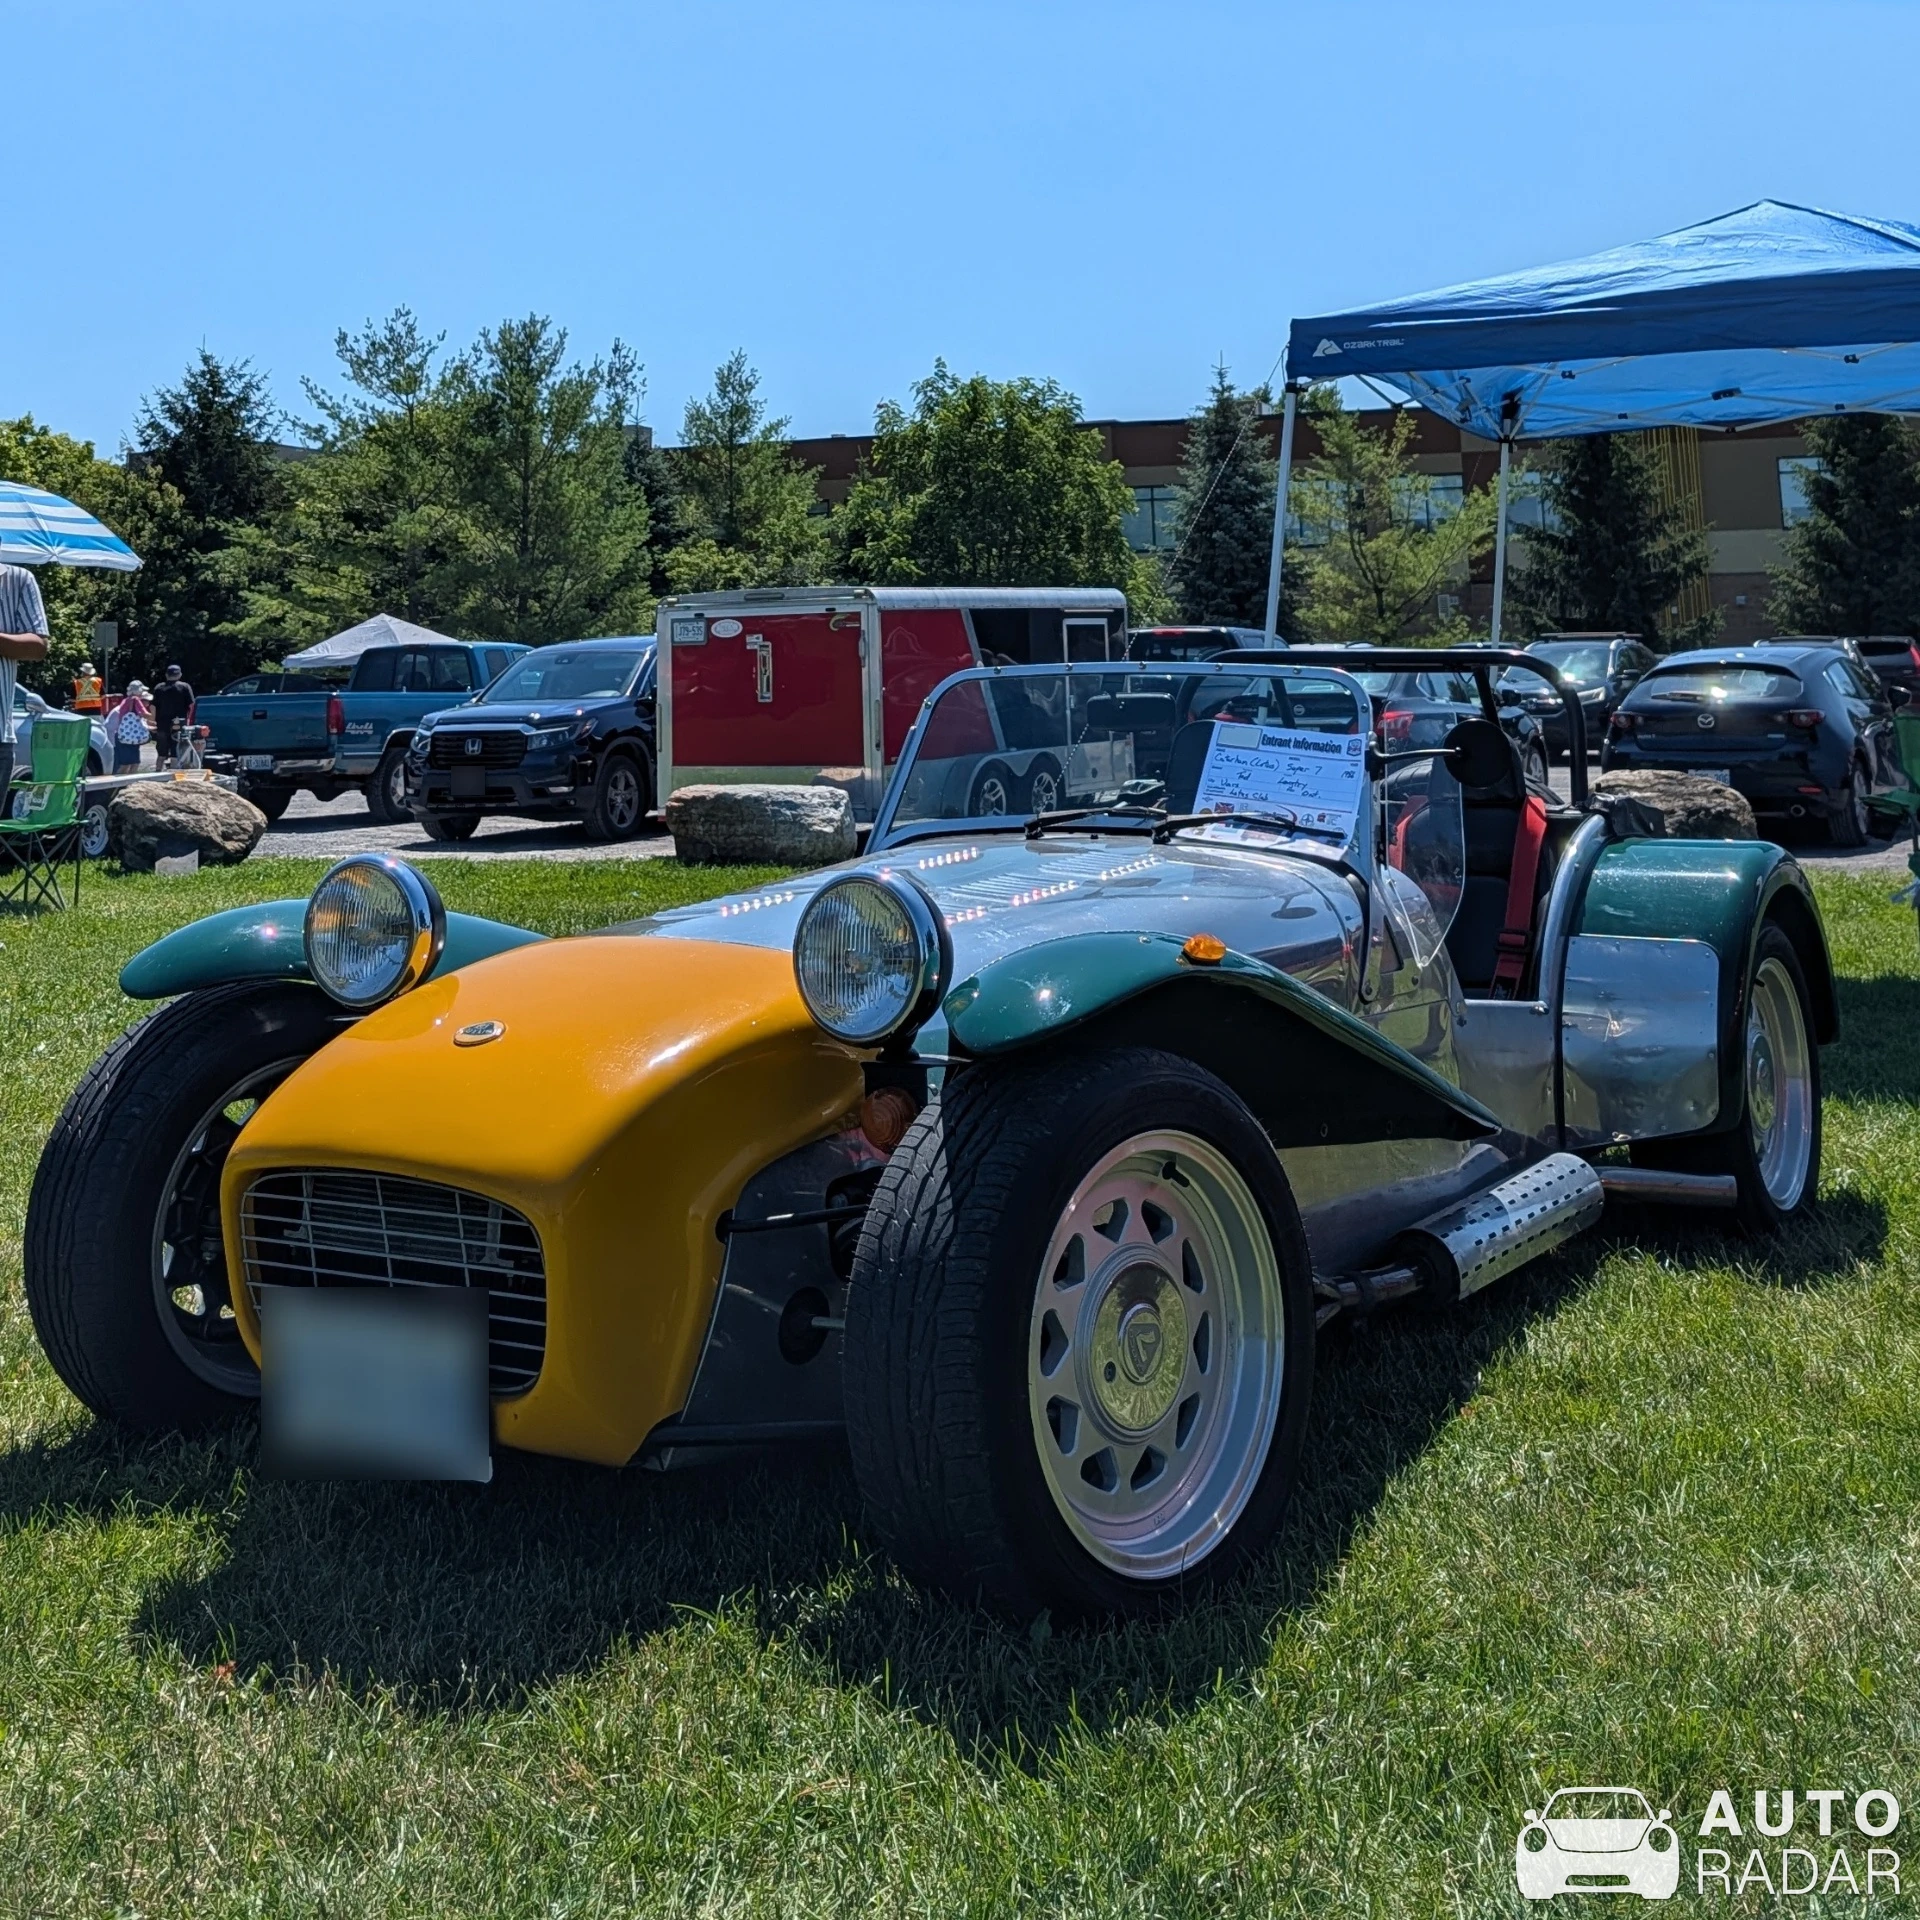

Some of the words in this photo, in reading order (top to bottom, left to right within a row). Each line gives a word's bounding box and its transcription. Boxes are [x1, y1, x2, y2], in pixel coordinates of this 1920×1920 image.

[1262, 734, 1291, 748] Entrant
[1293, 738, 1342, 754] Information
[1286, 763, 1310, 776] Super
[1315, 765, 1323, 776] 7
